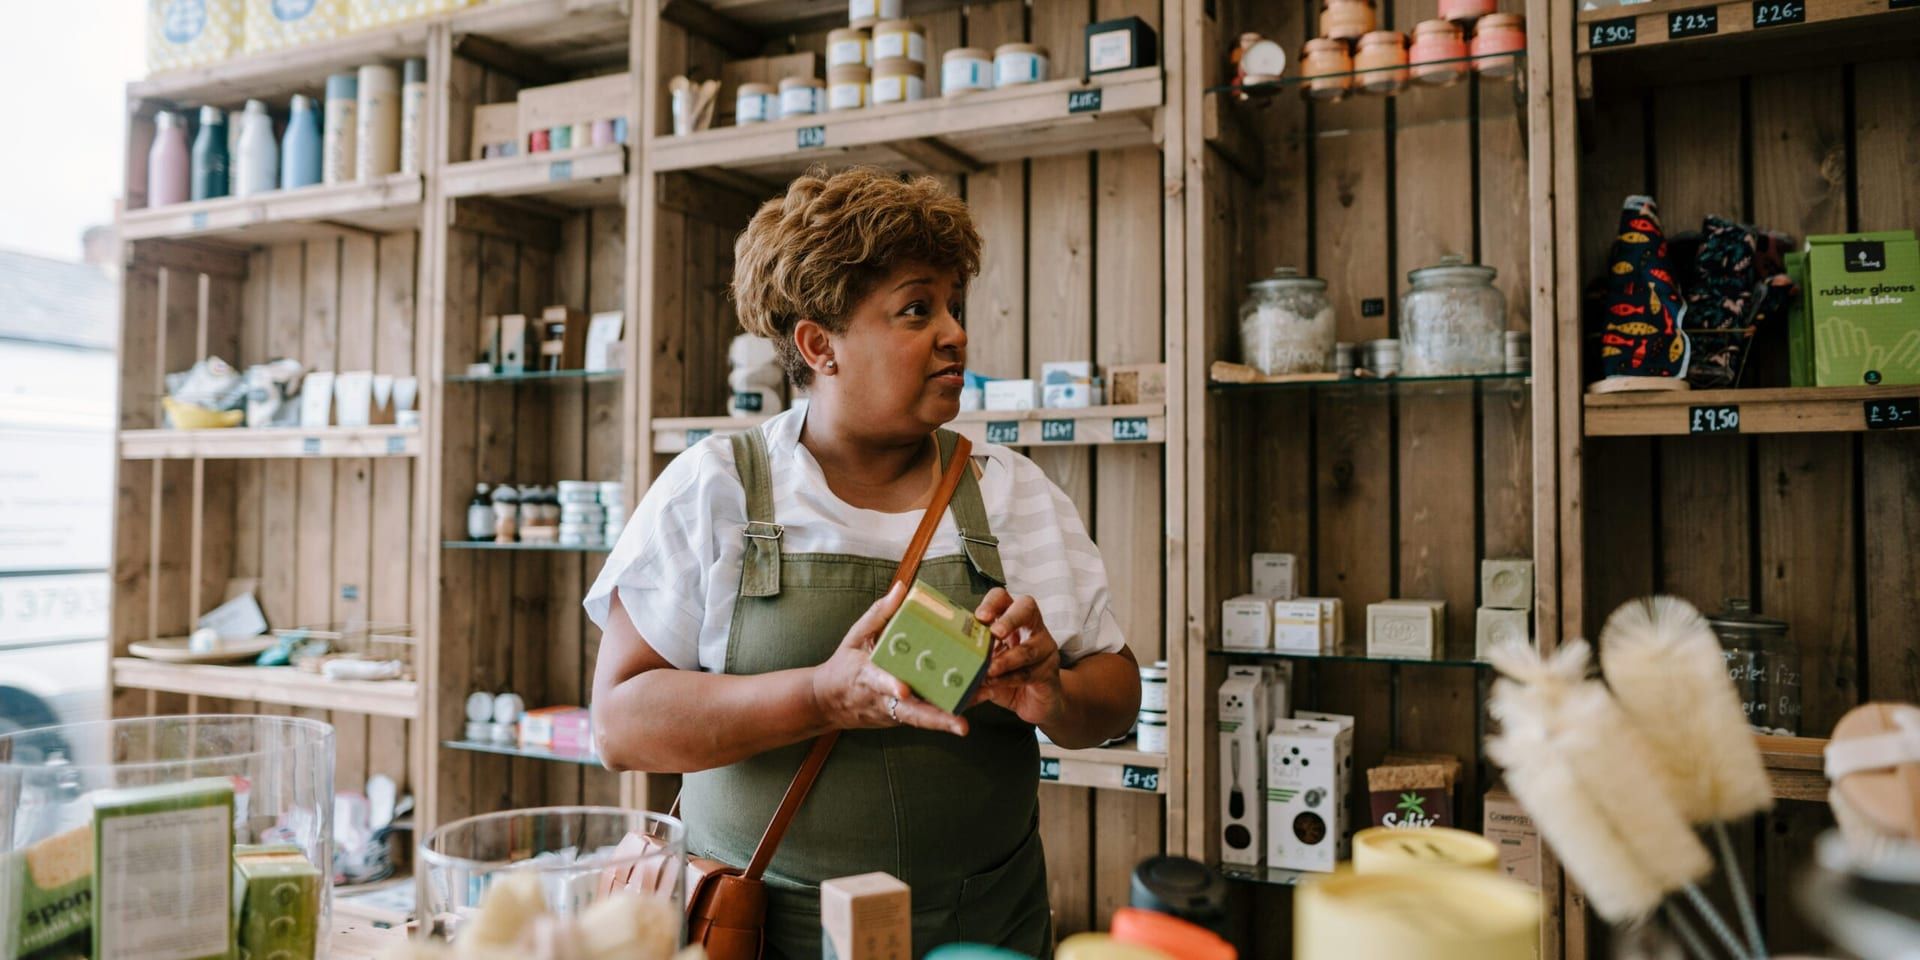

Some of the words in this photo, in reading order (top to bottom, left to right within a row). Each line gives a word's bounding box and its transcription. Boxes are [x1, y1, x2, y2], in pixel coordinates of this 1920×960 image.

[1820, 285, 1866, 296] rubber
[1869, 283, 1916, 297] gloves
[1832, 296, 1872, 307] natural
[1874, 295, 1904, 305] latex
[1691, 408, 1739, 432] £9.50
[1729, 663, 1768, 682] oilet
